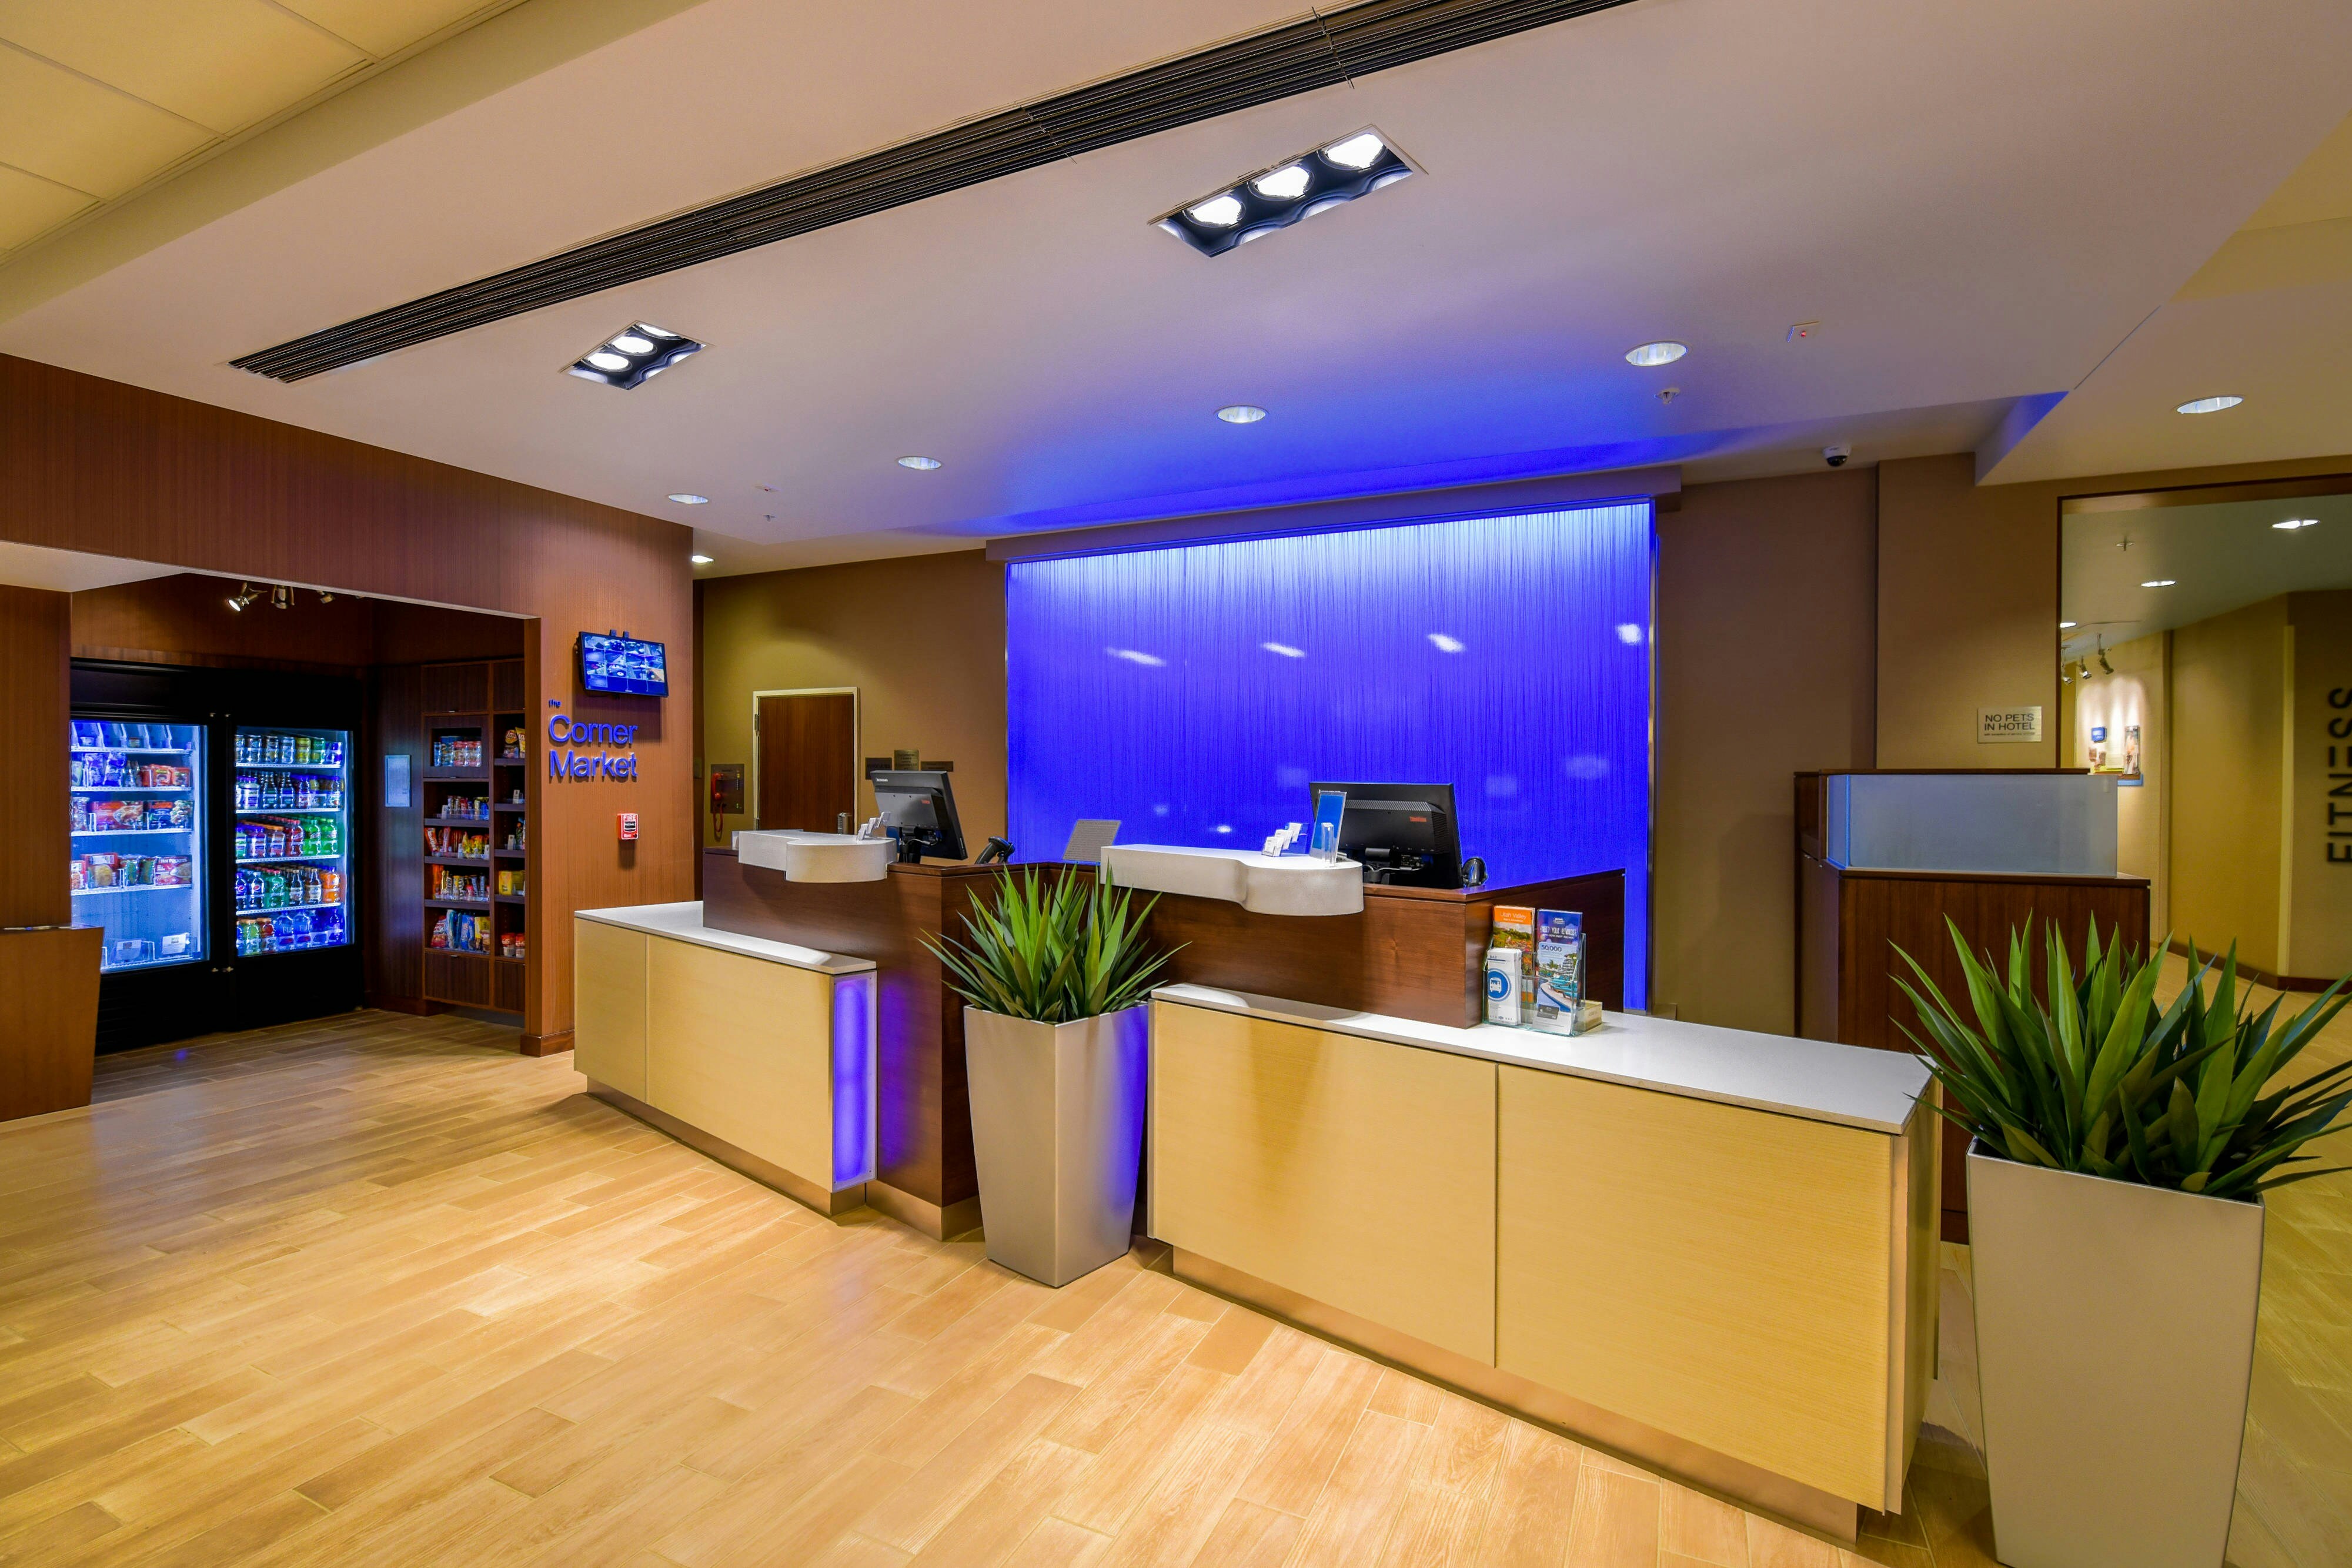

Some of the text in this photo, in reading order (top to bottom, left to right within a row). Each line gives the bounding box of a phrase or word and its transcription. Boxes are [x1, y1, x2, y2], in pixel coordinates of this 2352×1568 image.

[1984, 721, 2036, 731] IN HOTEL
[2006, 713, 2034, 722] PETS
[549, 714, 638, 744] Corner
[550, 750, 638, 777] Market
